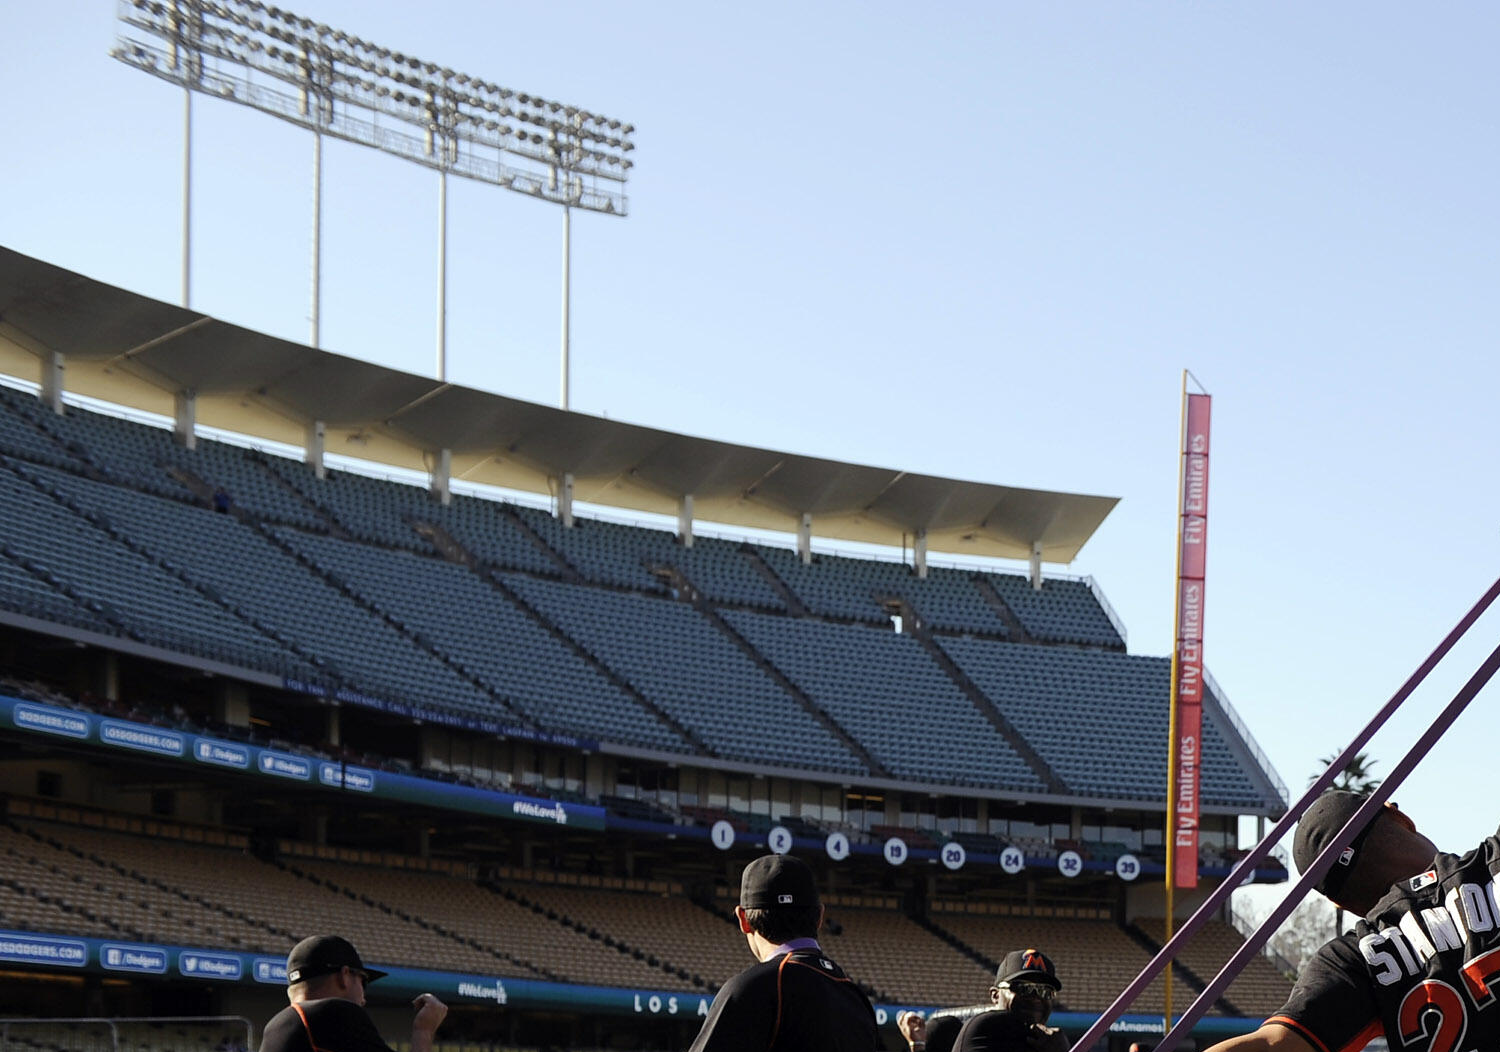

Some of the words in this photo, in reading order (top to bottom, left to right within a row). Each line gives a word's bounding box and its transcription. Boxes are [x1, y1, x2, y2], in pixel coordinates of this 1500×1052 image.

[1186, 433, 1205, 512] Emirates
[1184, 514, 1204, 545] Fly
[1181, 584, 1199, 663] Emirates
[1179, 665, 1200, 696] Fly
[1176, 735, 1196, 813] Emirates
[720, 829, 726, 842] 1
[1176, 814, 1196, 847] Fly
[776, 834, 784, 848] 2
[833, 840, 841, 853] 4
[890, 845, 902, 858] 19
[946, 850, 961, 862] 20
[1005, 854, 1019, 867] 24
[1063, 858, 1078, 870] 32
[1121, 862, 1135, 874] 39
[0, 941, 84, 960] SDODGERS.COM
[634, 994, 679, 1015] LOS
